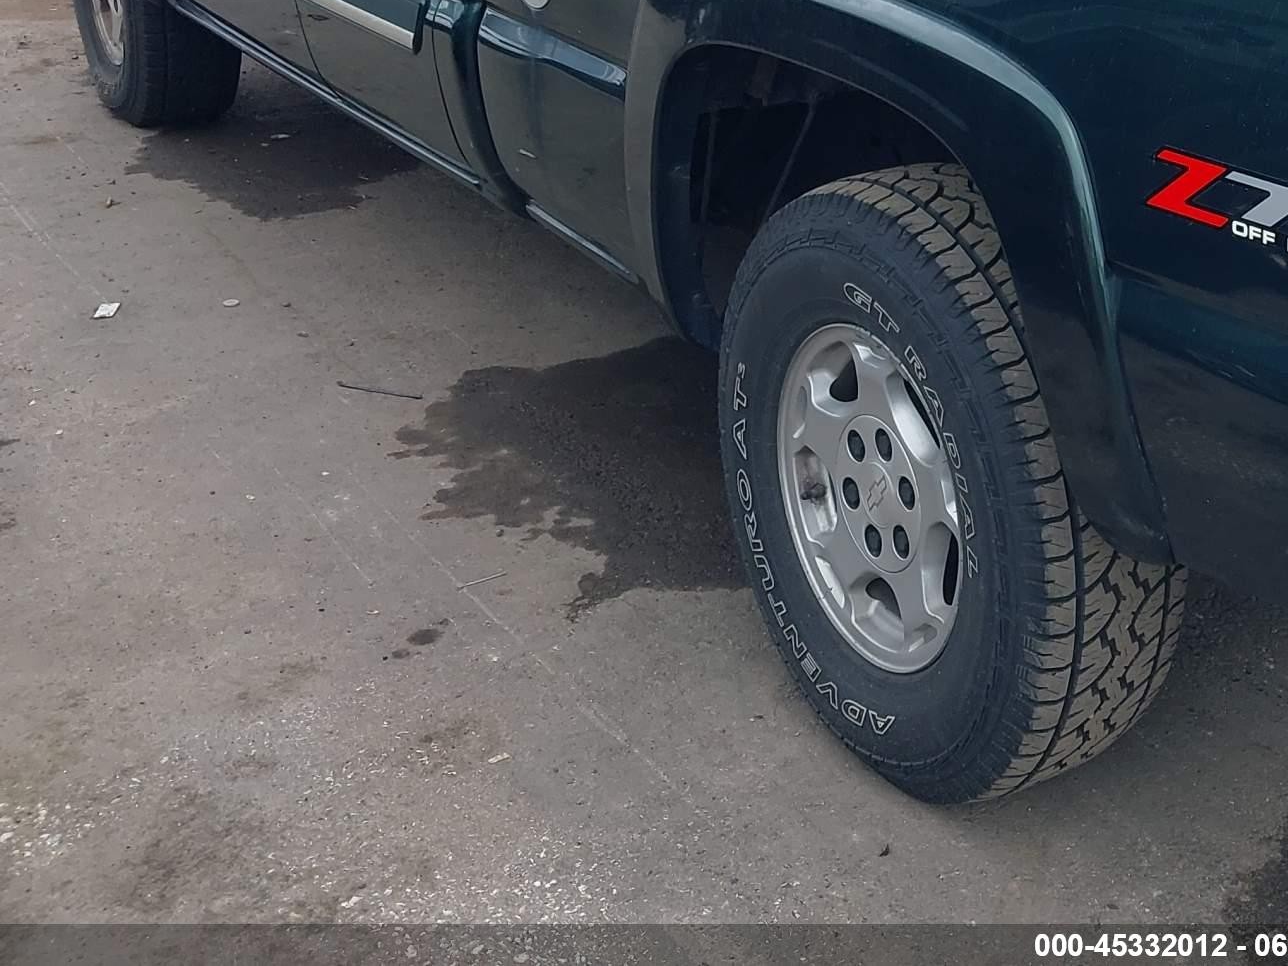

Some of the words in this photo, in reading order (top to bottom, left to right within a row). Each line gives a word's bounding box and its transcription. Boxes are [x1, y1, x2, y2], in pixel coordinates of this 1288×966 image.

[1231, 220, 1276, 245] OFF
[843, 283, 900, 334] GT
[904, 345, 979, 578] RADIAL
[736, 469, 895, 735] ADVENTURO
